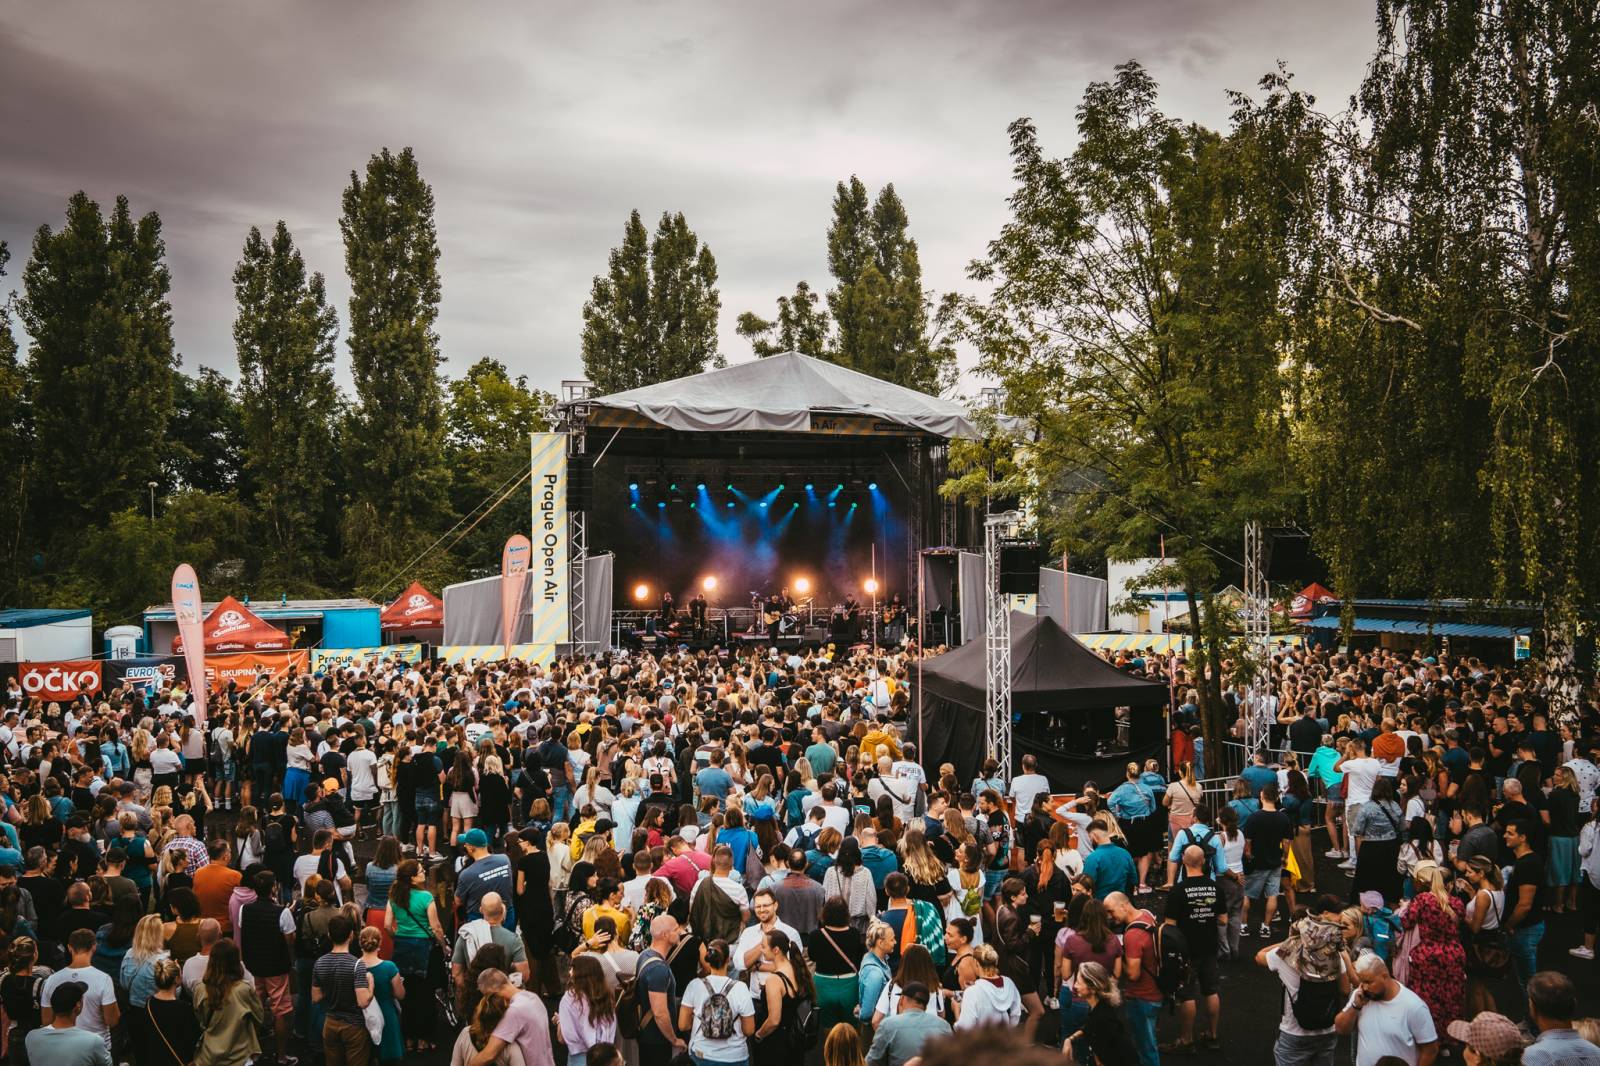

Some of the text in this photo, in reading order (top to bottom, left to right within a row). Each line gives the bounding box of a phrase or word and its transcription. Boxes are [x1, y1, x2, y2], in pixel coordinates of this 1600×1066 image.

[541, 474, 558, 602] Prague Open Air
[23, 668, 98, 692] ÓČKO
[220, 668, 257, 677] SKUPINA
